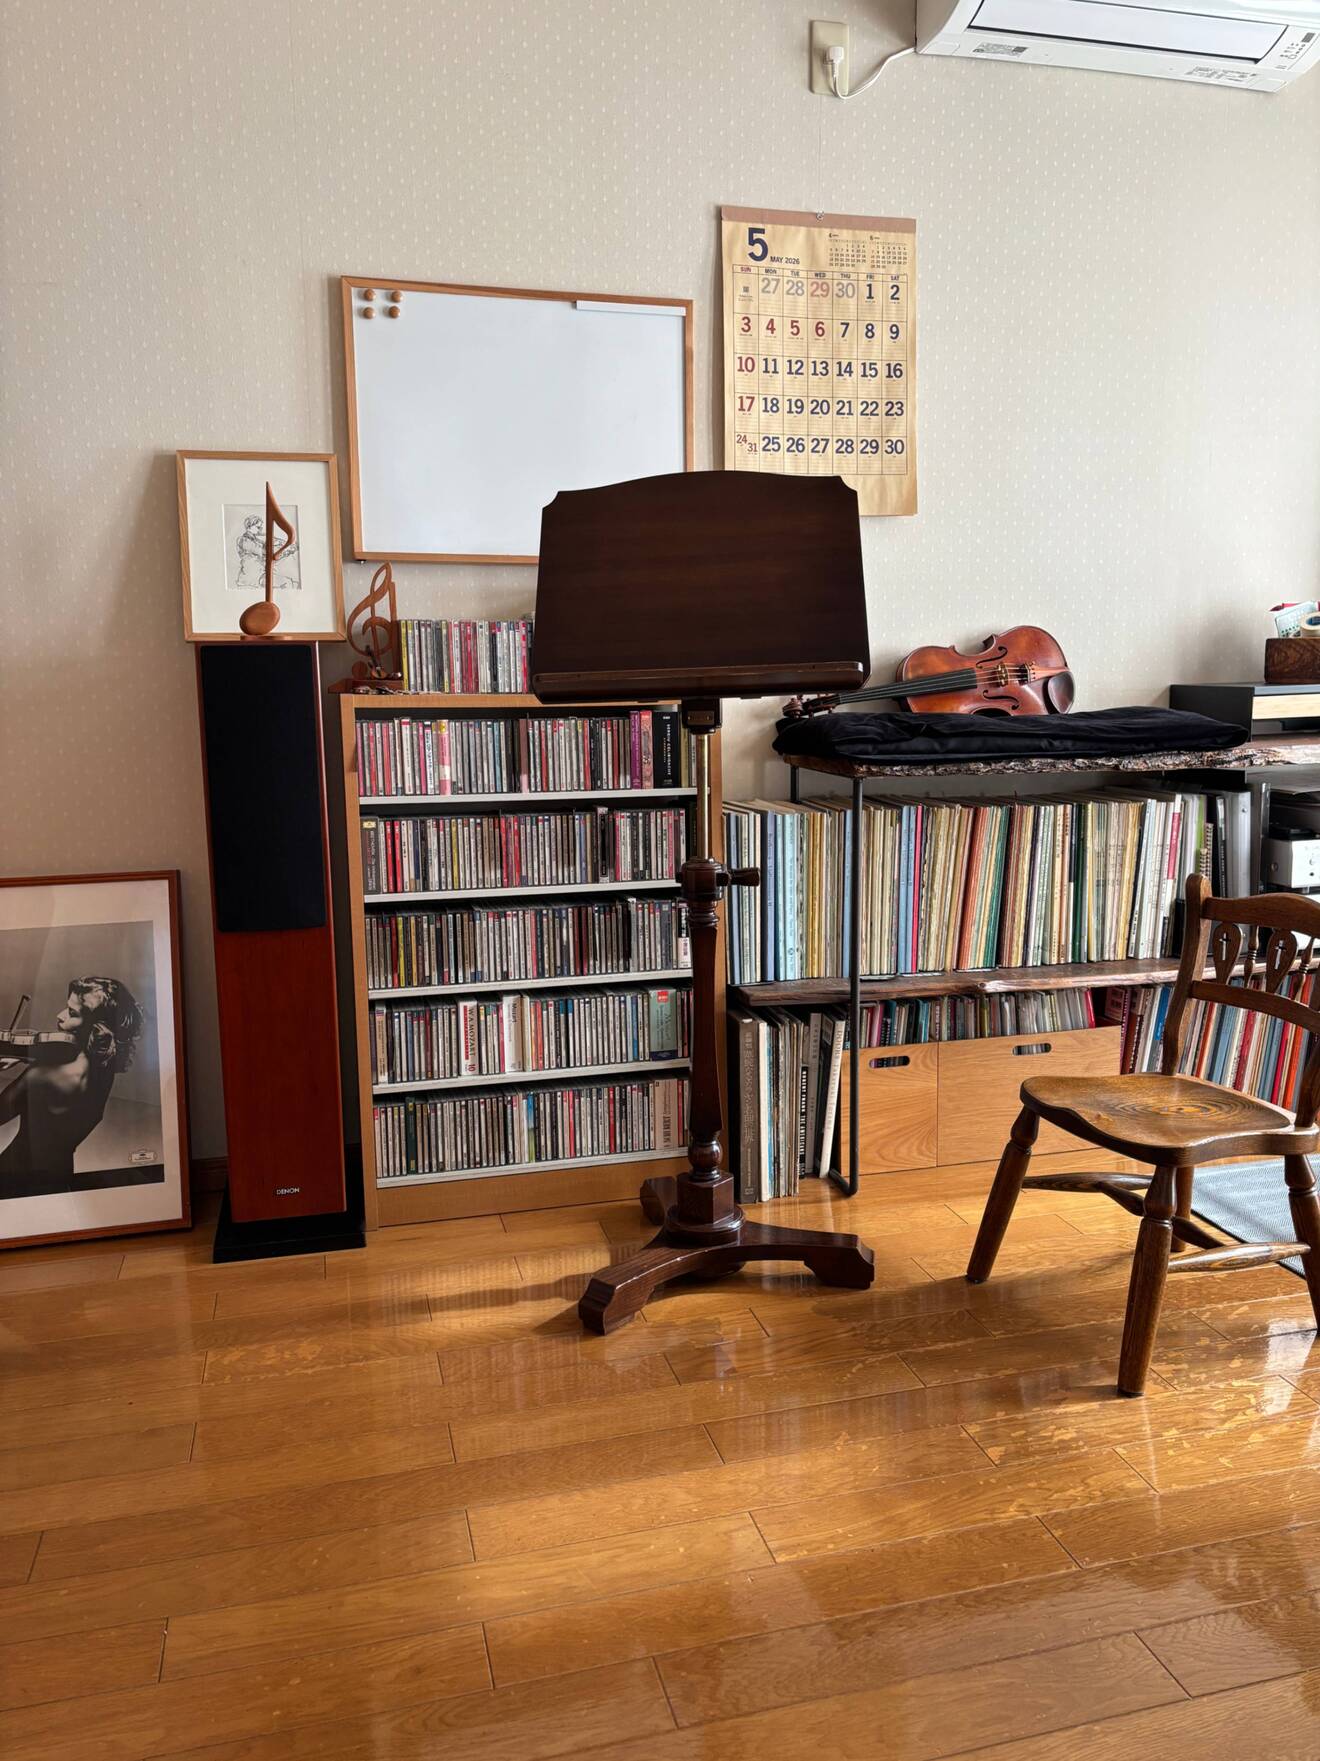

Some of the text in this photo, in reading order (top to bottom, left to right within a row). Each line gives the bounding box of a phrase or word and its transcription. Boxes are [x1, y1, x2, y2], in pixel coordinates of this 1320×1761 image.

[748, 227, 768, 262] 5
[770, 255, 800, 265] MAY 2026
[761, 277, 780, 294] 27
[786, 280, 804, 296] 28
[810, 281, 830, 297] 29
[835, 282, 855, 298] 30
[866, 284, 874, 299] 1
[890, 284, 900, 300] 2
[741, 316, 900, 340] 3 4 5 6 7 8 9
[737, 356, 903, 378] 10 11 12 13 14 15 16
[738, 396, 904, 416] 17 18 19 20 21 22 23
[736, 434, 904, 454] 24 31 25 26 27 28 29 30
